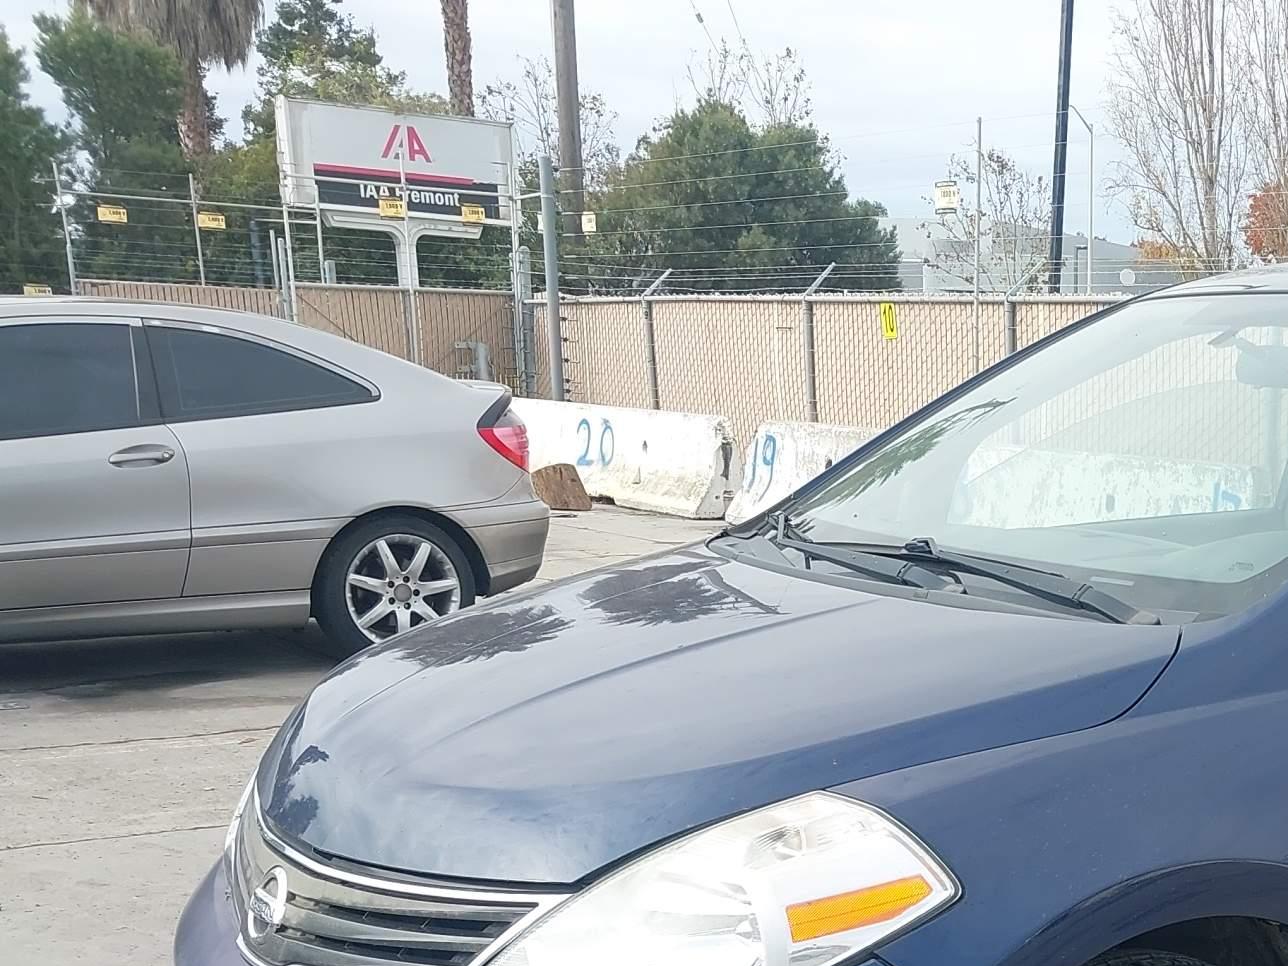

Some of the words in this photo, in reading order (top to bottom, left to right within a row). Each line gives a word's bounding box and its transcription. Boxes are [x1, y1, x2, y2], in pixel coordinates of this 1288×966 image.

[360, 183, 391, 200] IAA
[883, 304, 895, 333] 10
[576, 418, 615, 467] 20
[750, 434, 777, 503] 19
